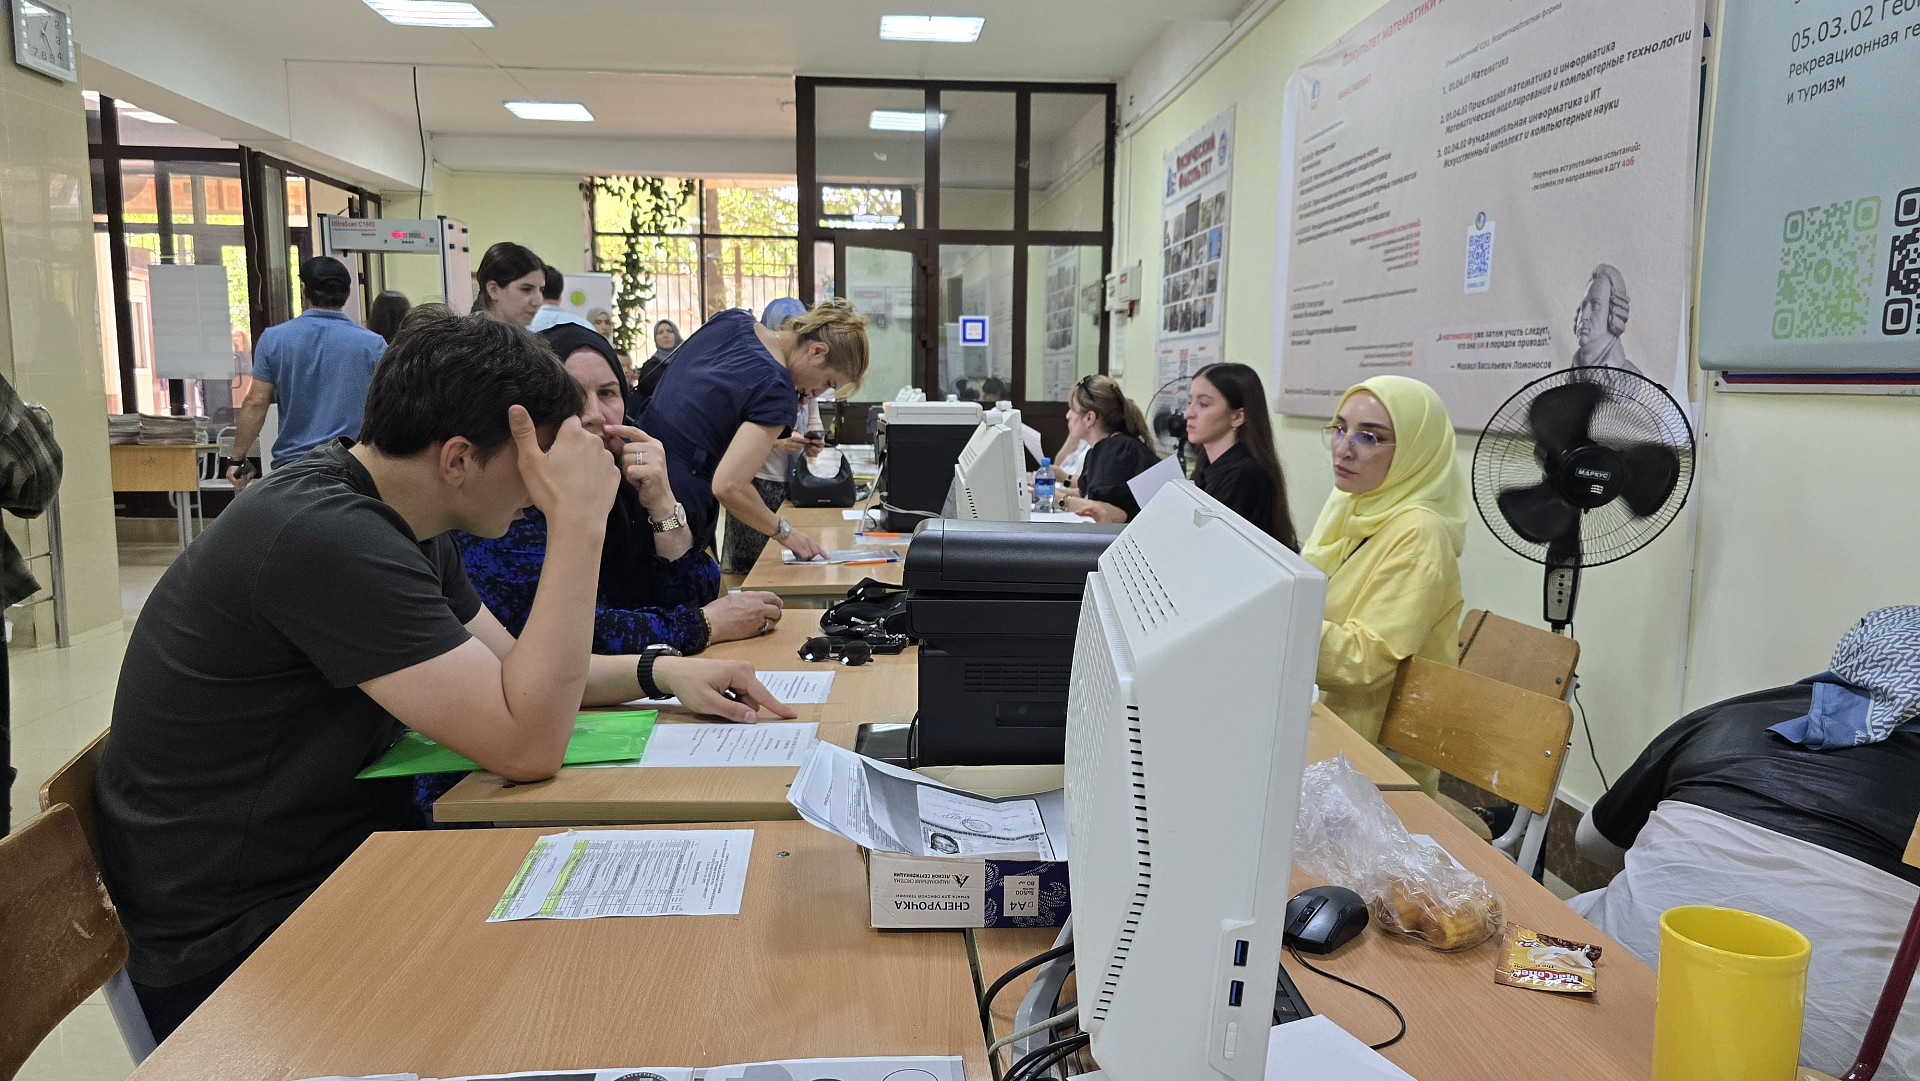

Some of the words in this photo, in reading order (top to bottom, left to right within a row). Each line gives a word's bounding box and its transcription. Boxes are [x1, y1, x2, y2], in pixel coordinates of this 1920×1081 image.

[1382, 0, 1437, 40] математики
[1791, 5, 1874, 52] 05.03.02
[1881, 0, 1920, 21] Гео
[1789, 31, 1898, 78] Рекреационная
[1445, 104, 1468, 122] 01.04.02
[1468, 88, 1506, 112] Прикладная
[1507, 69, 1552, 96] математика
[1559, 41, 1616, 73] информатика
[1445, 108, 1496, 135] Математическое
[1496, 85, 1552, 114] моделирование
[1559, 54, 1625, 89] компьютерные
[1626, 30, 1692, 62] технологии
[1448, 74, 1470, 93] 01.04.01
[1471, 56, 1509, 80] Математика
[1786, 91, 1794, 105] и
[1797, 75, 1846, 102] туризм
[1443, 138, 1467, 156] 02.04.02
[1467, 117, 1528, 147] Фундаментальная
[1528, 96, 1582, 124] информатика
[1590, 87, 1602, 101] ИТ
[1443, 143, 1490, 168] Искусственный
[1490, 132, 1524, 153] интеллект
[1530, 108, 1592, 138] компьютерные
[1593, 98, 1620, 116] науки
[1532, 167, 1560, 180] Перечень
[1560, 154, 1603, 173] вступительных
[1603, 141, 1641, 160] испытаний:
[1565, 166, 1604, 184] направлению
[1609, 160, 1621, 173] ДГУ
[1473, 331, 1485, 340] уже
[1485, 330, 1504, 338] затем
[1504, 328, 1523, 339] учить
[1524, 326, 1550, 336] следует,
[1490, 340, 1516, 350] порядок
[1477, 361, 1512, 370] Васильевич
[1512, 360, 1552, 370] Ломоносов
[1577, 468, 1609, 479] МАРКУС
[894, 900, 970, 911] СНЕГУРОЧКА
[1009, 901, 1027, 911] A4
[1513, 967, 1580, 984] MacCoffee
